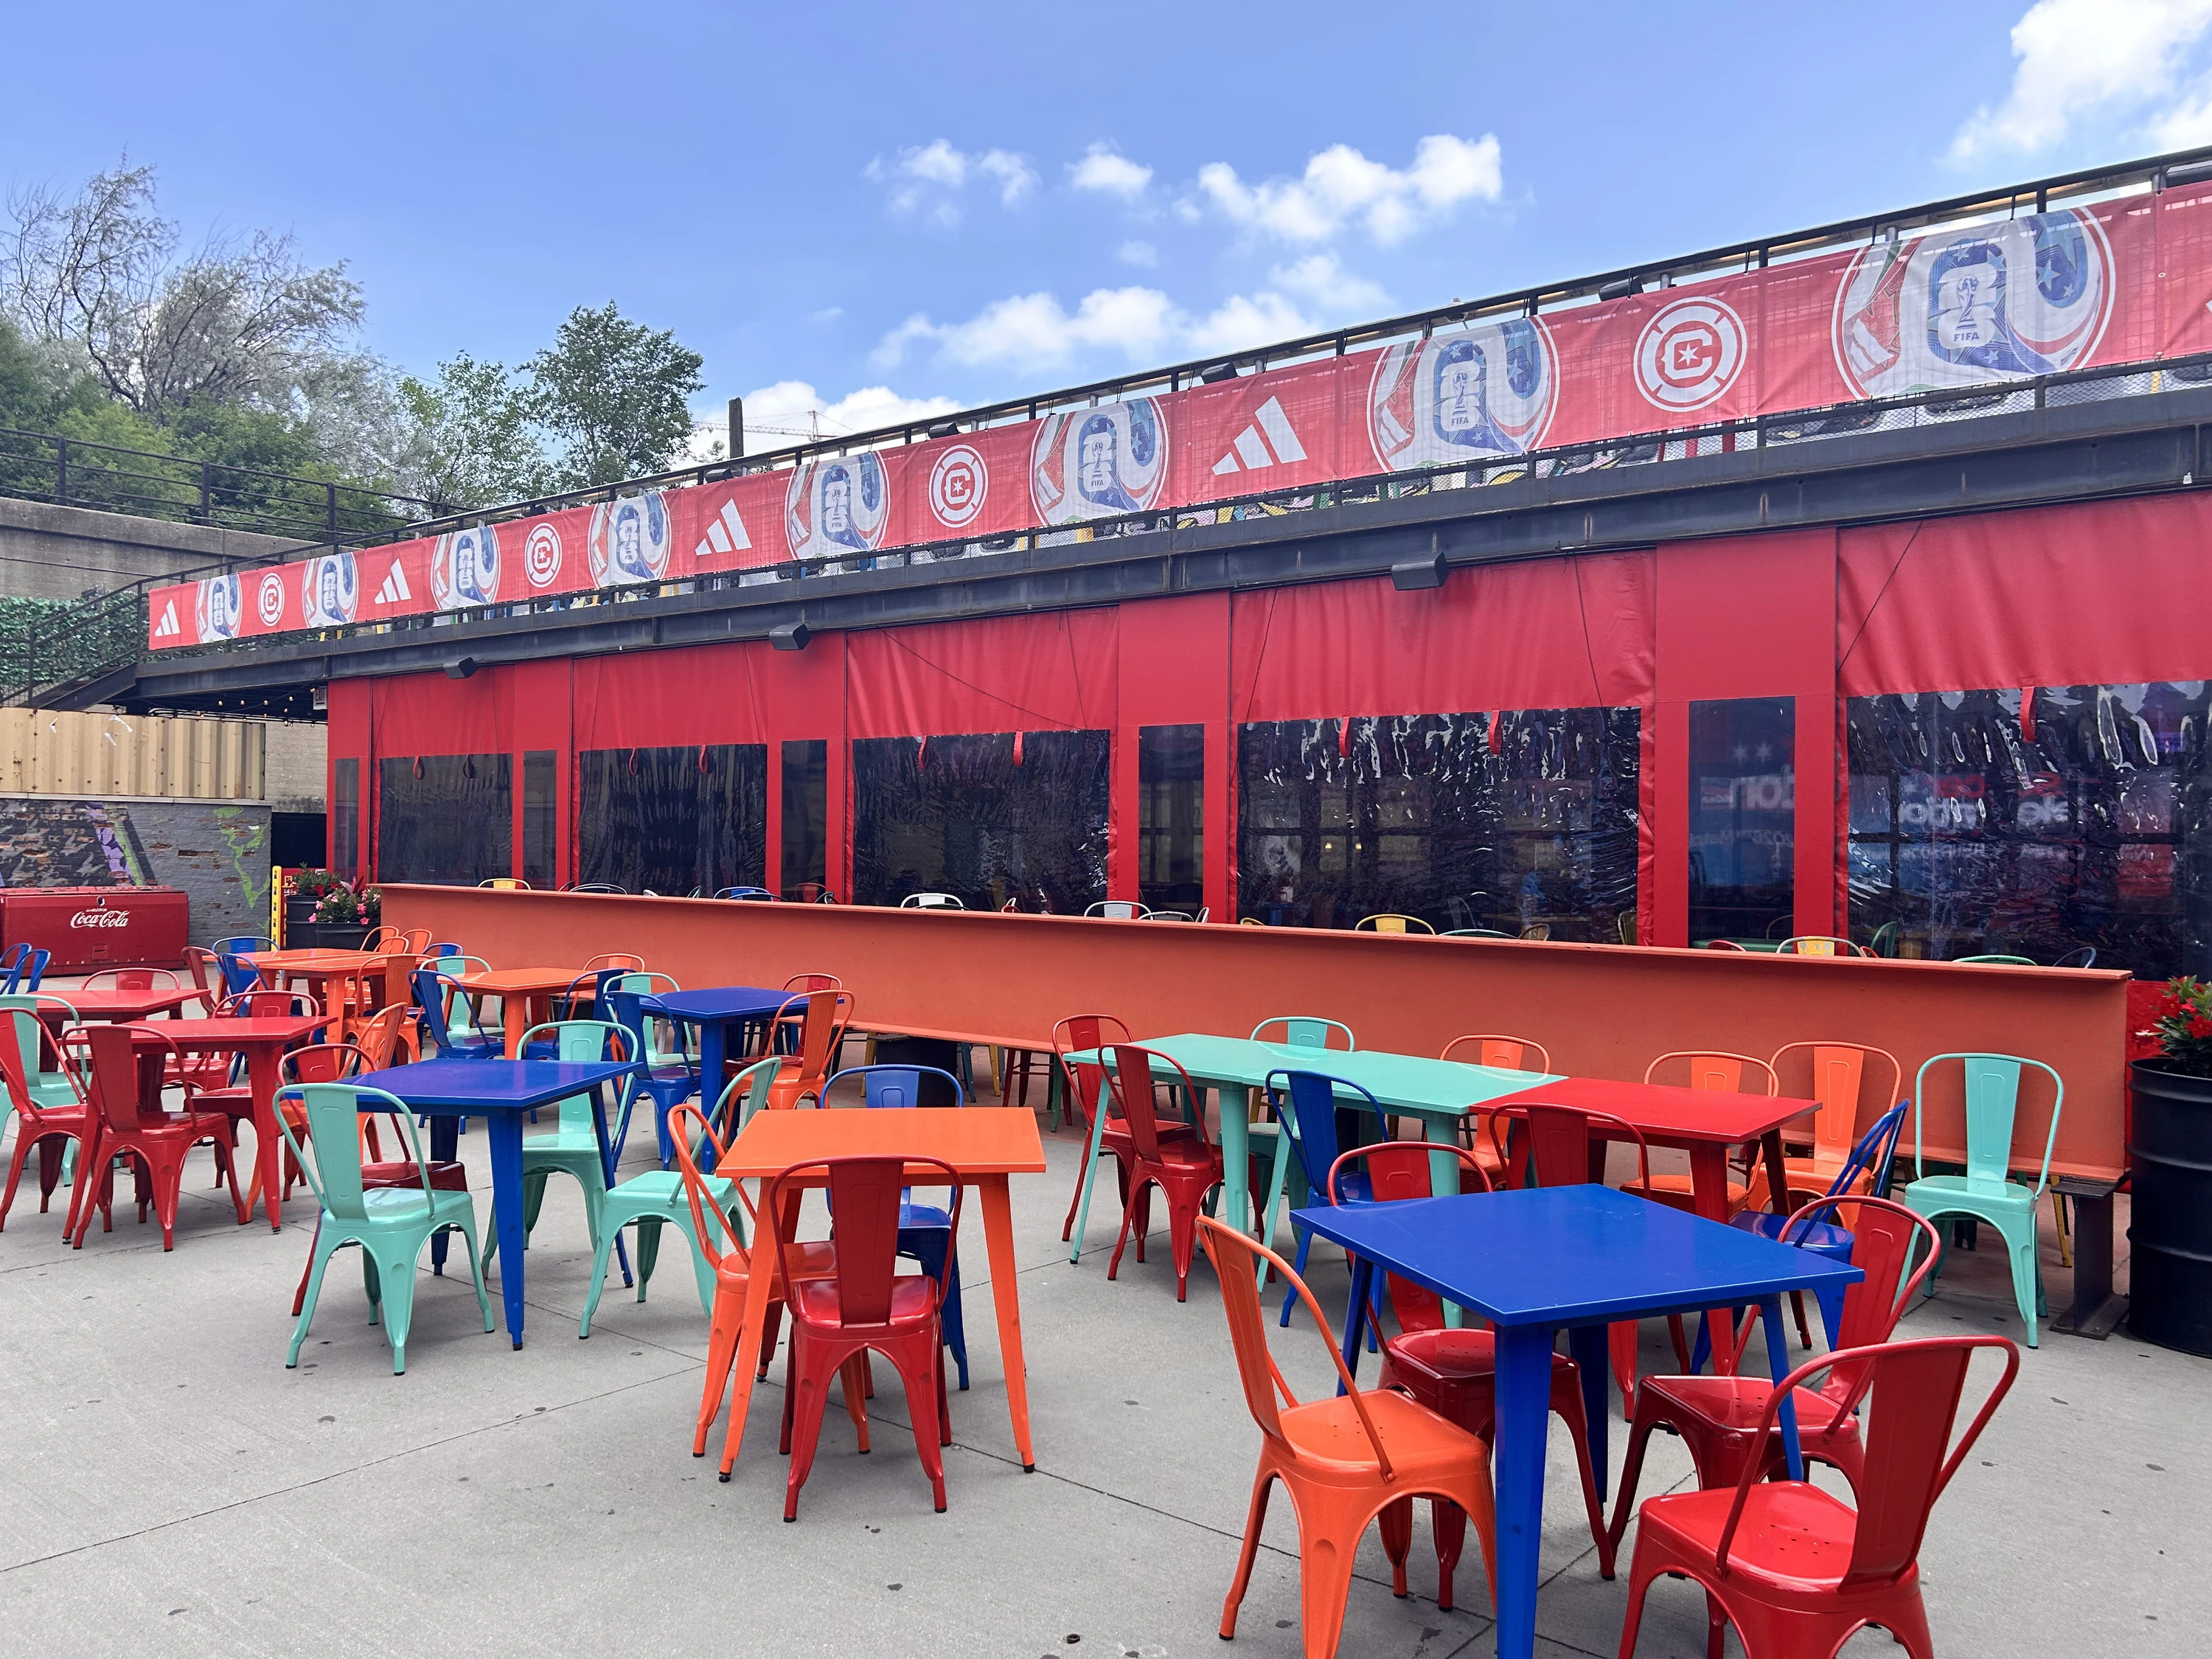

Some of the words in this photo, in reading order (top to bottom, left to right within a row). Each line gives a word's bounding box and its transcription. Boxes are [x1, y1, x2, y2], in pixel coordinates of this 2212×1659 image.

[1953, 332, 1980, 342] FIFA
[1451, 416, 1469, 425] FIFA
[70, 910, 131, 928] Coca-Cola
